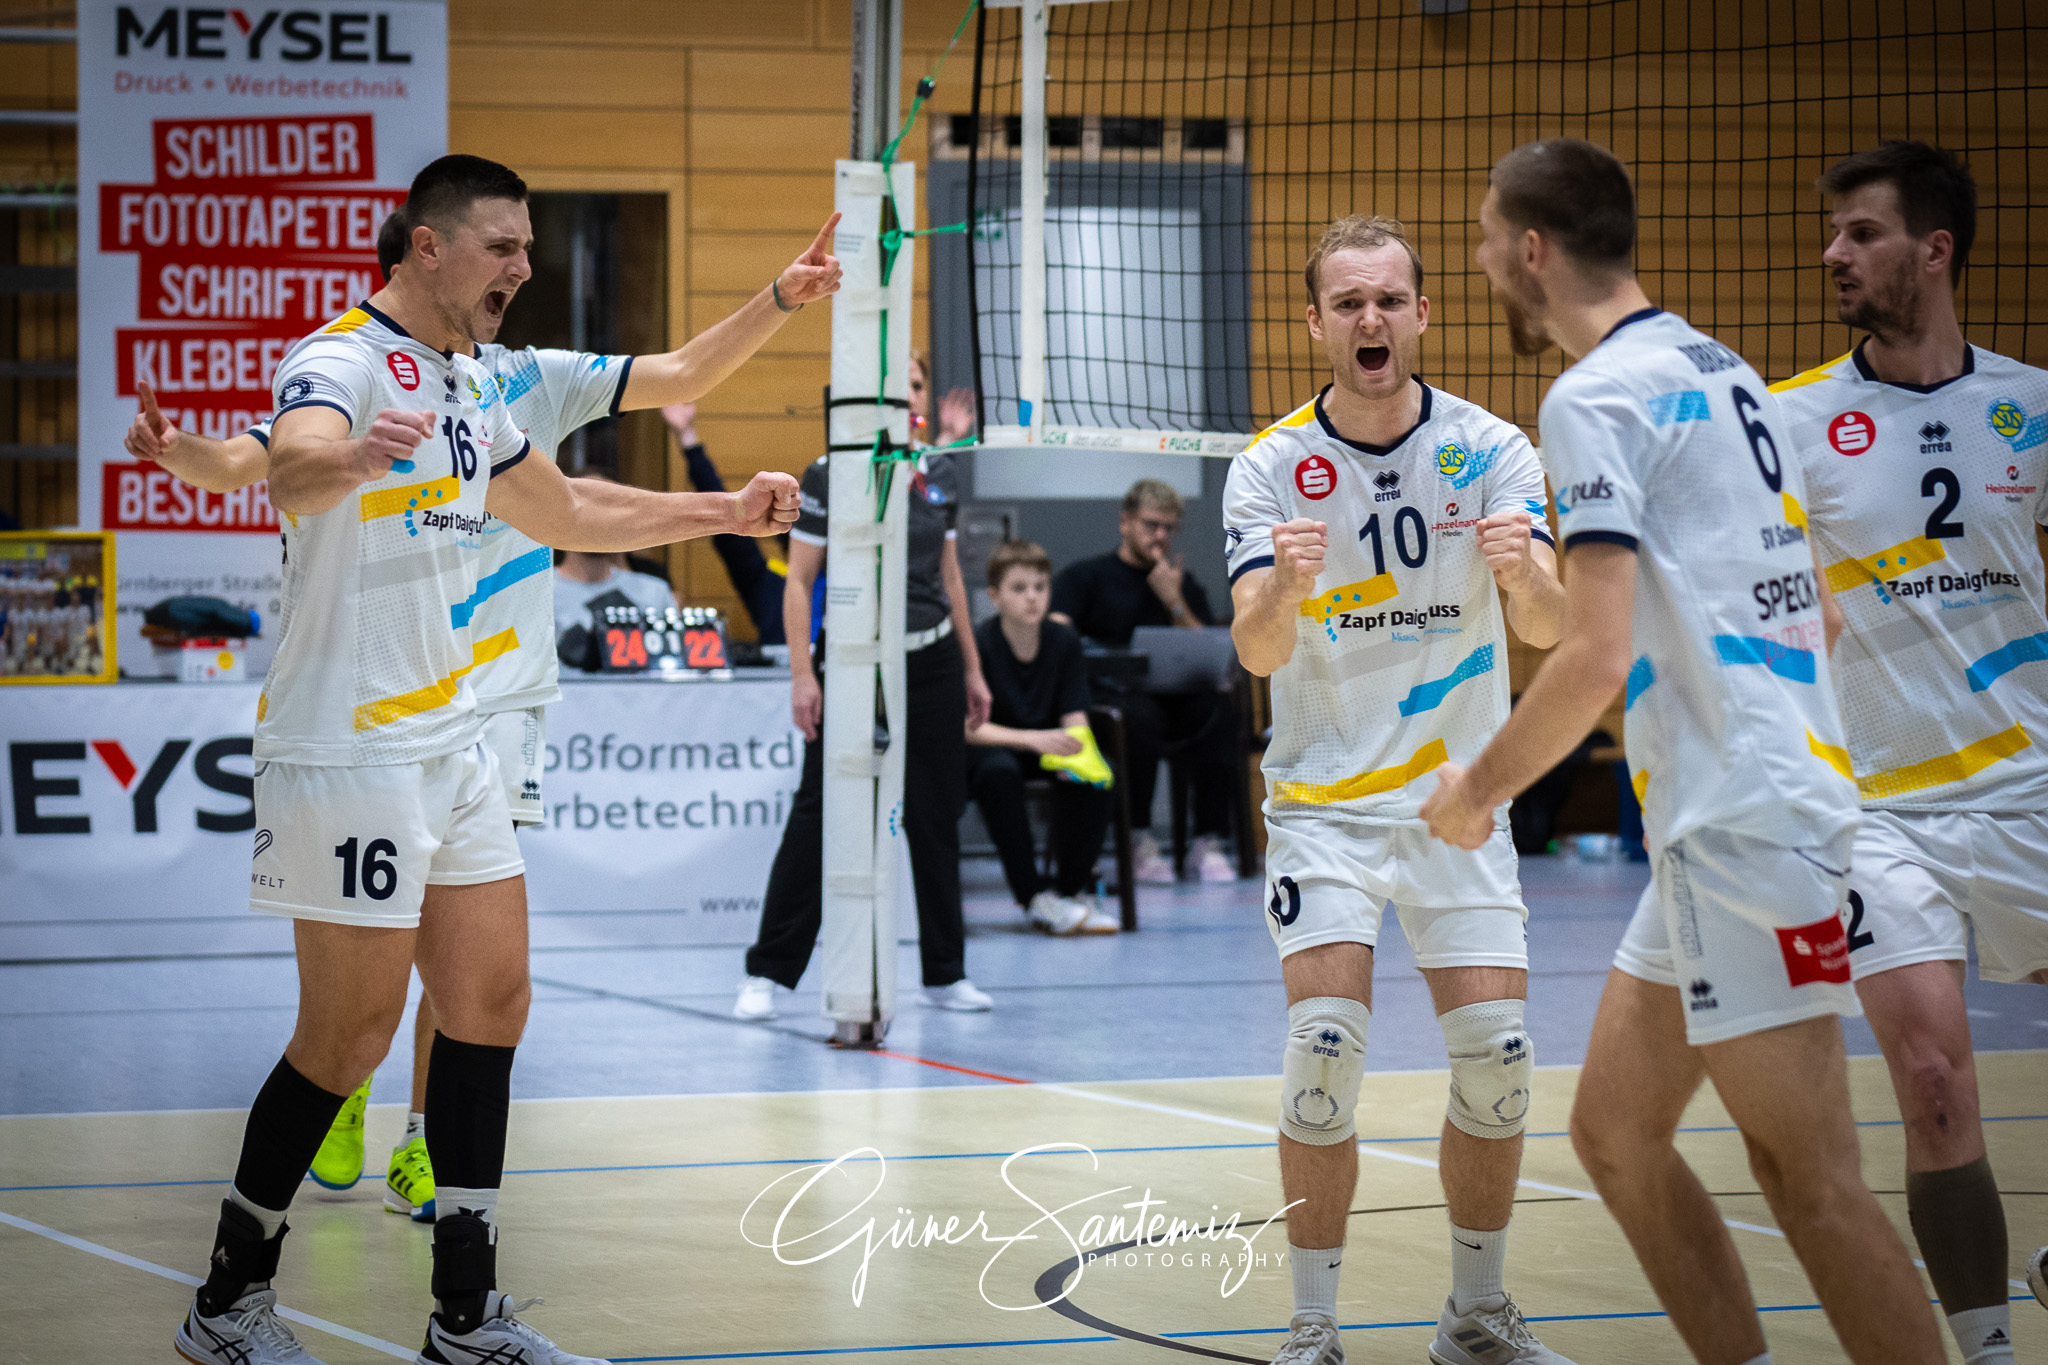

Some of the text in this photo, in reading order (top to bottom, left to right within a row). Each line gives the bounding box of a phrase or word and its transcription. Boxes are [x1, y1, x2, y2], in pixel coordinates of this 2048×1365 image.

[116, 6, 413, 64] MEYSEL
[114, 71, 192, 94] Druck
[225, 73, 408, 98] Werbetechnik
[165, 122, 360, 178] SCHILDER
[119, 193, 397, 249] FOTOTAPETEN
[158, 263, 373, 321] SCHRIFTEN
[133, 338, 302, 391] KLEBEF
[441, 416, 478, 481] 16
[1042, 432, 1067, 445] UCHS
[1169, 437, 1202, 452] FUCHS
[1732, 384, 1782, 494] 6
[1920, 441, 1952, 454] errea
[118, 471, 281, 527] BESCHR
[1571, 474, 1613, 507] puls
[1921, 467, 1964, 540] 2
[423, 510, 454, 531] Zapf
[1359, 506, 1428, 575] 10
[1886, 569, 2021, 598] Zapf Daigfuss
[1339, 604, 1461, 631] Zapf Daiguss
[606, 628, 648, 667] 24
[684, 630, 726, 667] 22
[545, 733, 795, 772] oßformatd
[0, 737, 256, 834] EYS
[335, 837, 398, 900] 16
[1313, 1045, 1340, 1058] errea
[1503, 1051, 1526, 1065] errea
